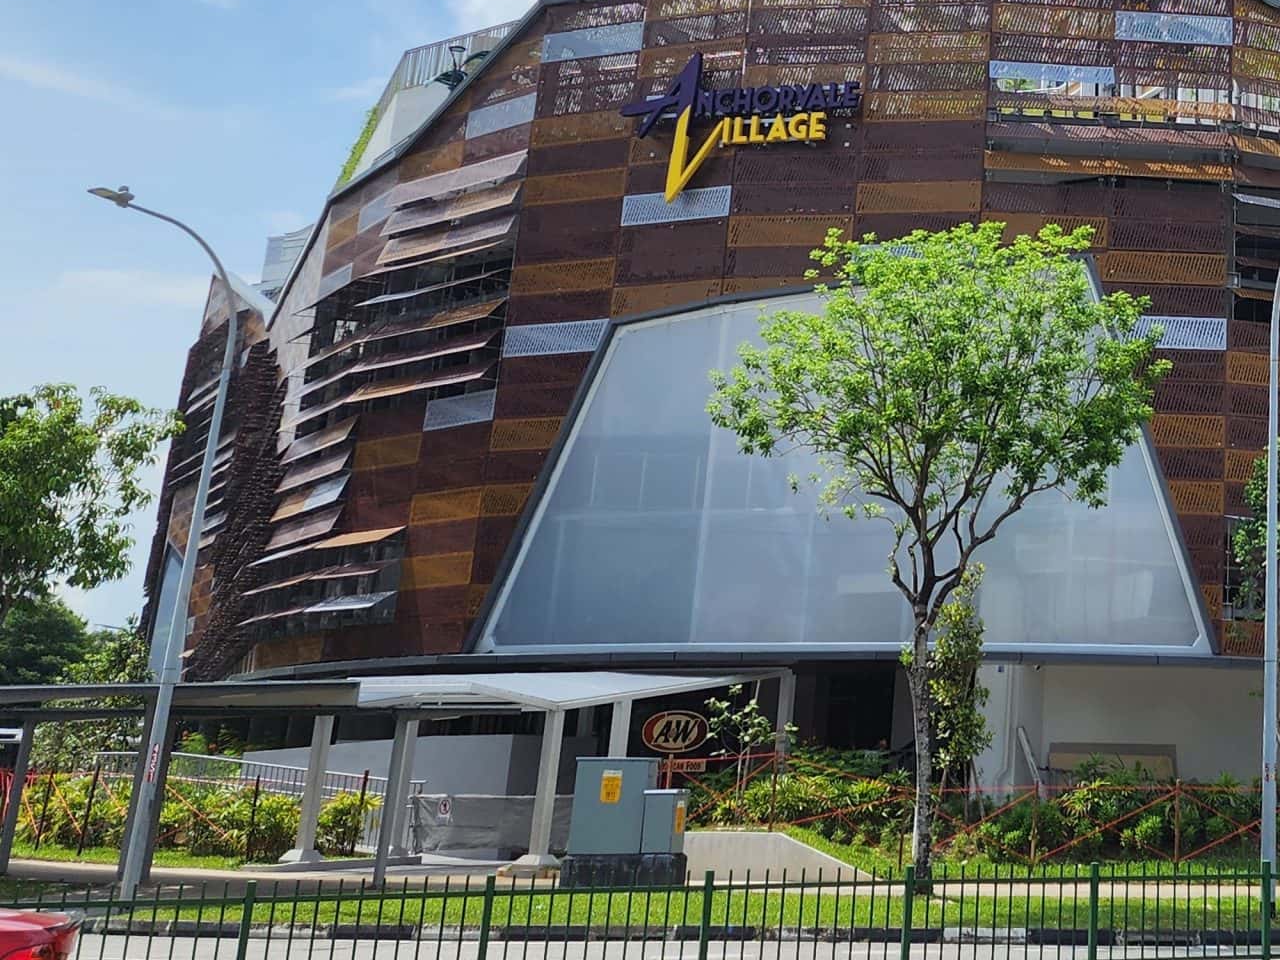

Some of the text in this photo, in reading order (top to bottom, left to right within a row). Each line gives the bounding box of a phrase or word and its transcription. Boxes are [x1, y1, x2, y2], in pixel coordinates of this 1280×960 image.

[619, 52, 860, 139] ANCHORVALE
[664, 104, 827, 204] VILLAGE
[652, 718, 701, 744] A&W
